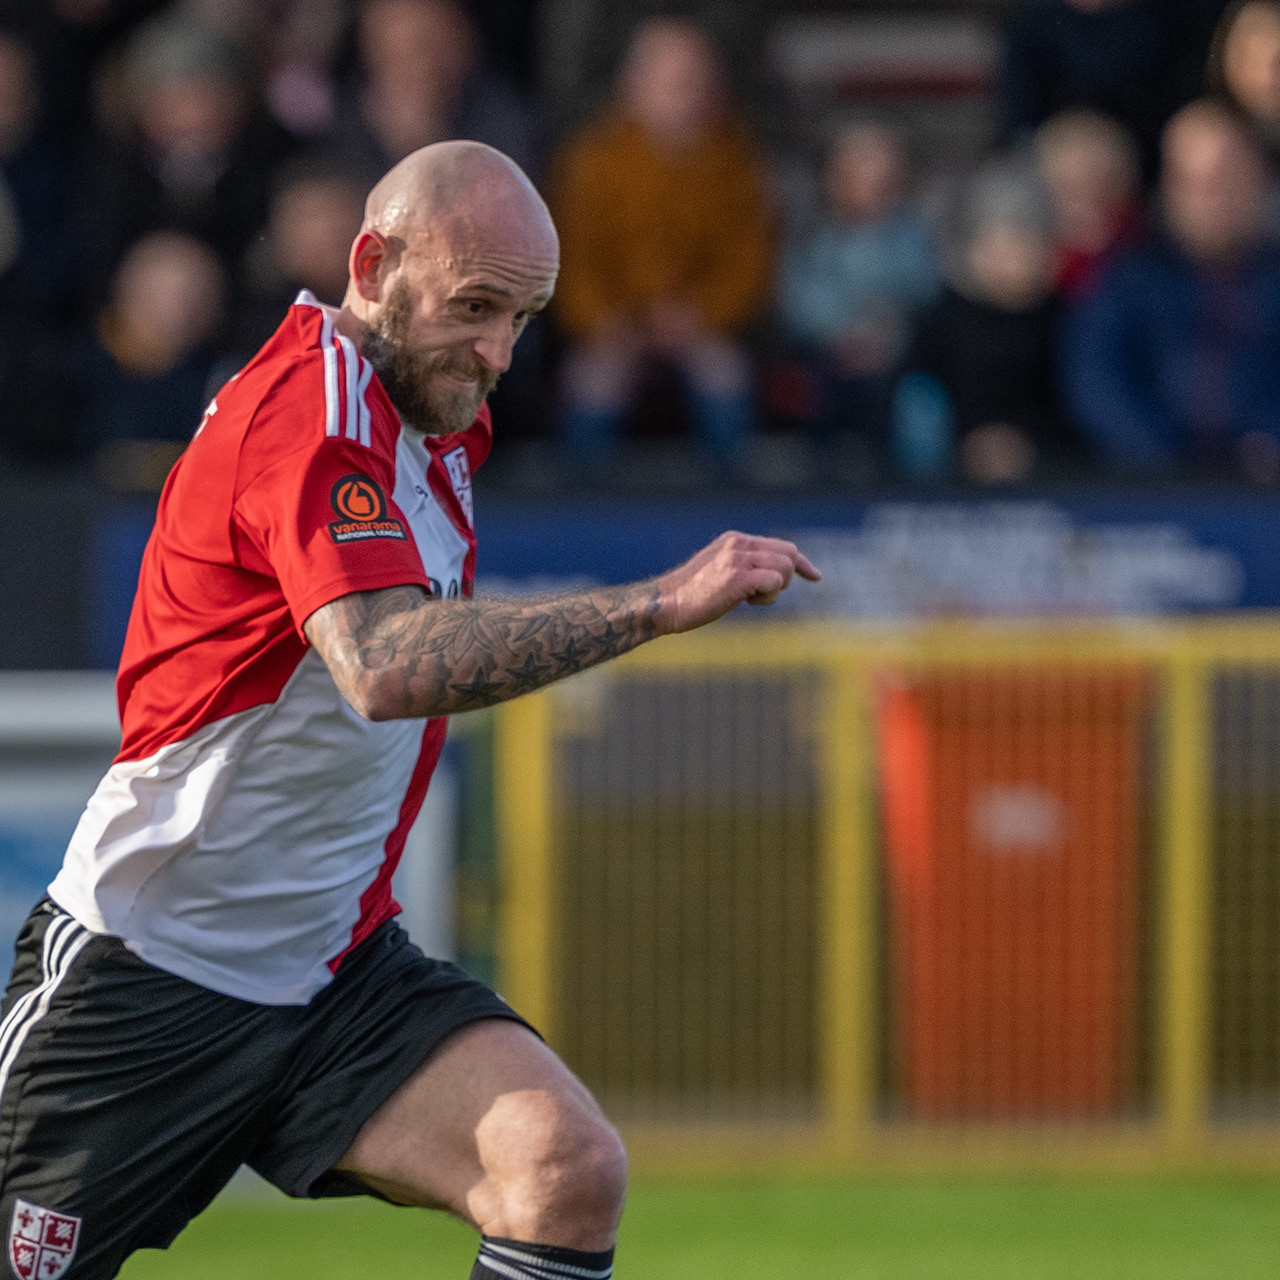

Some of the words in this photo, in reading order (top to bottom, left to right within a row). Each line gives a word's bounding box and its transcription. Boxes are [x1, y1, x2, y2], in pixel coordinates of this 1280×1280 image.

[333, 521, 402, 534] vanarama
[336, 530, 376, 541] NATIONAL
[375, 530, 404, 538] LEAGUE
